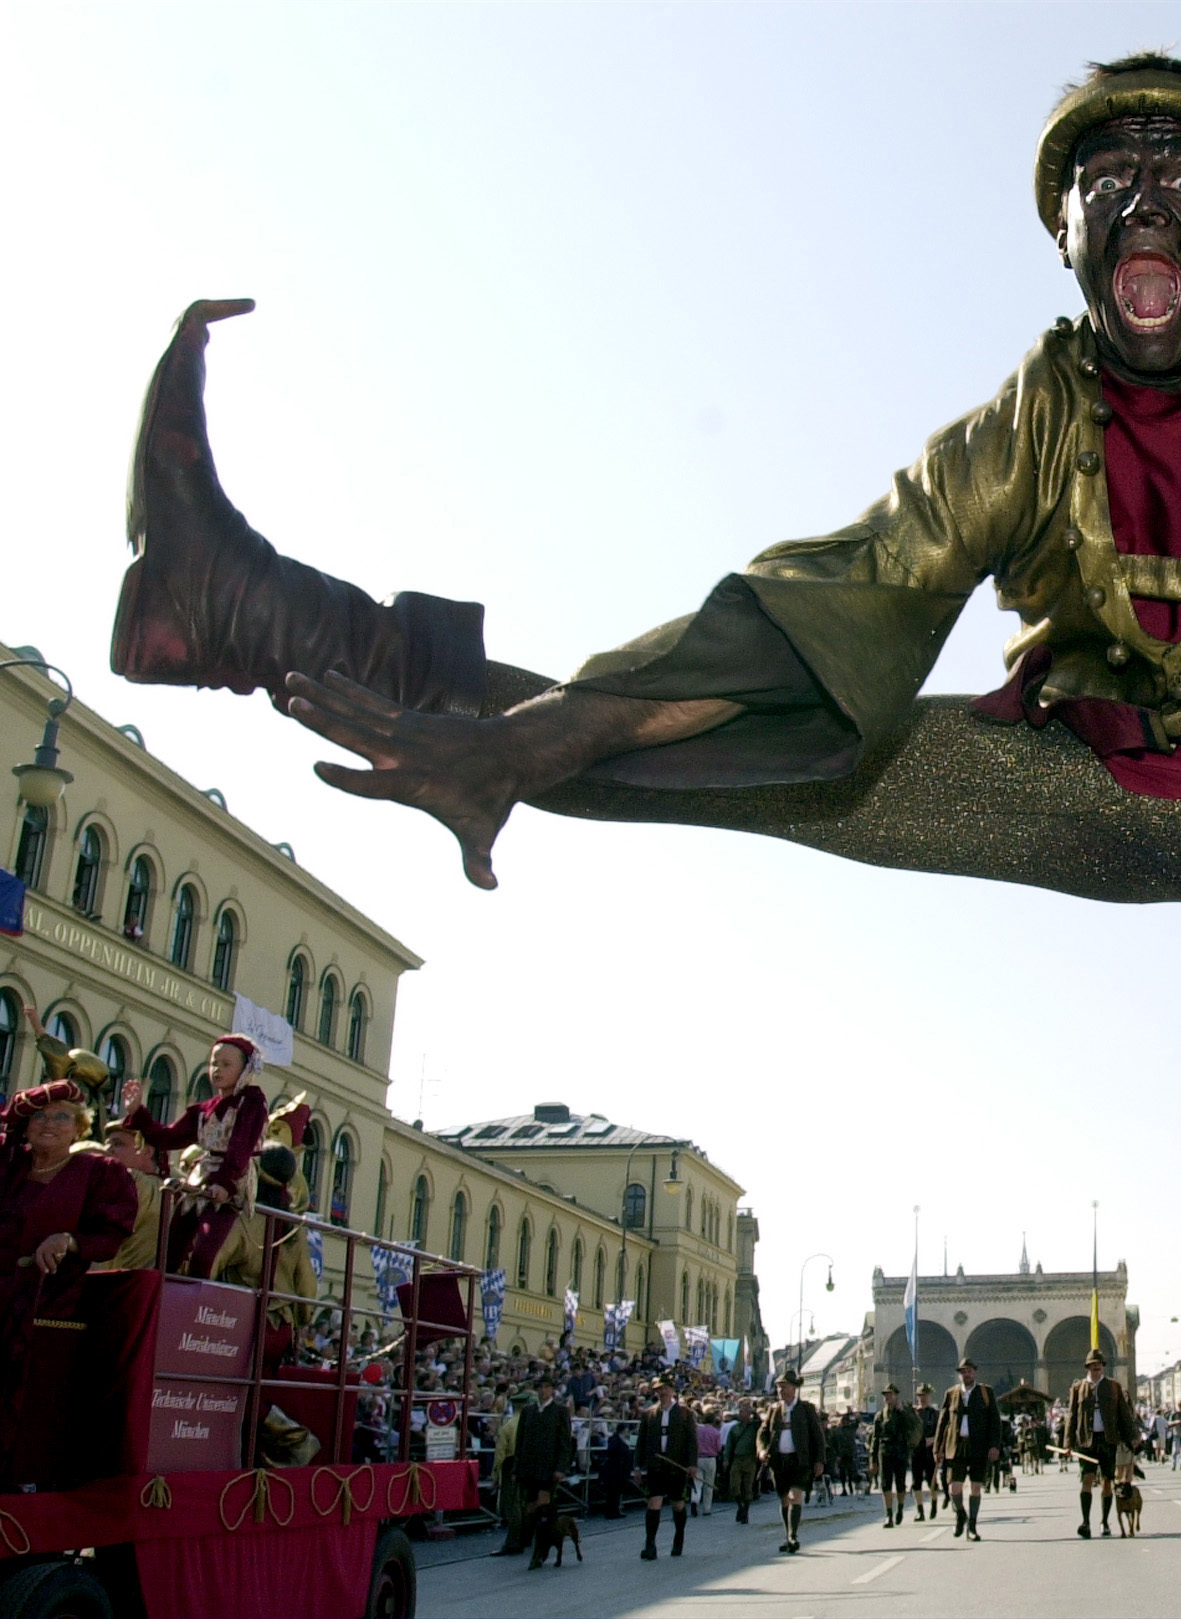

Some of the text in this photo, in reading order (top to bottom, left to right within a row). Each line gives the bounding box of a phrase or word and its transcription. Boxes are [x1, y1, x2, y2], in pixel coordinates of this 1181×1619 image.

[23, 908, 49, 936] AL.
[54, 922, 155, 988] OPPENHEIM
[171, 1420, 210, 1438] München
